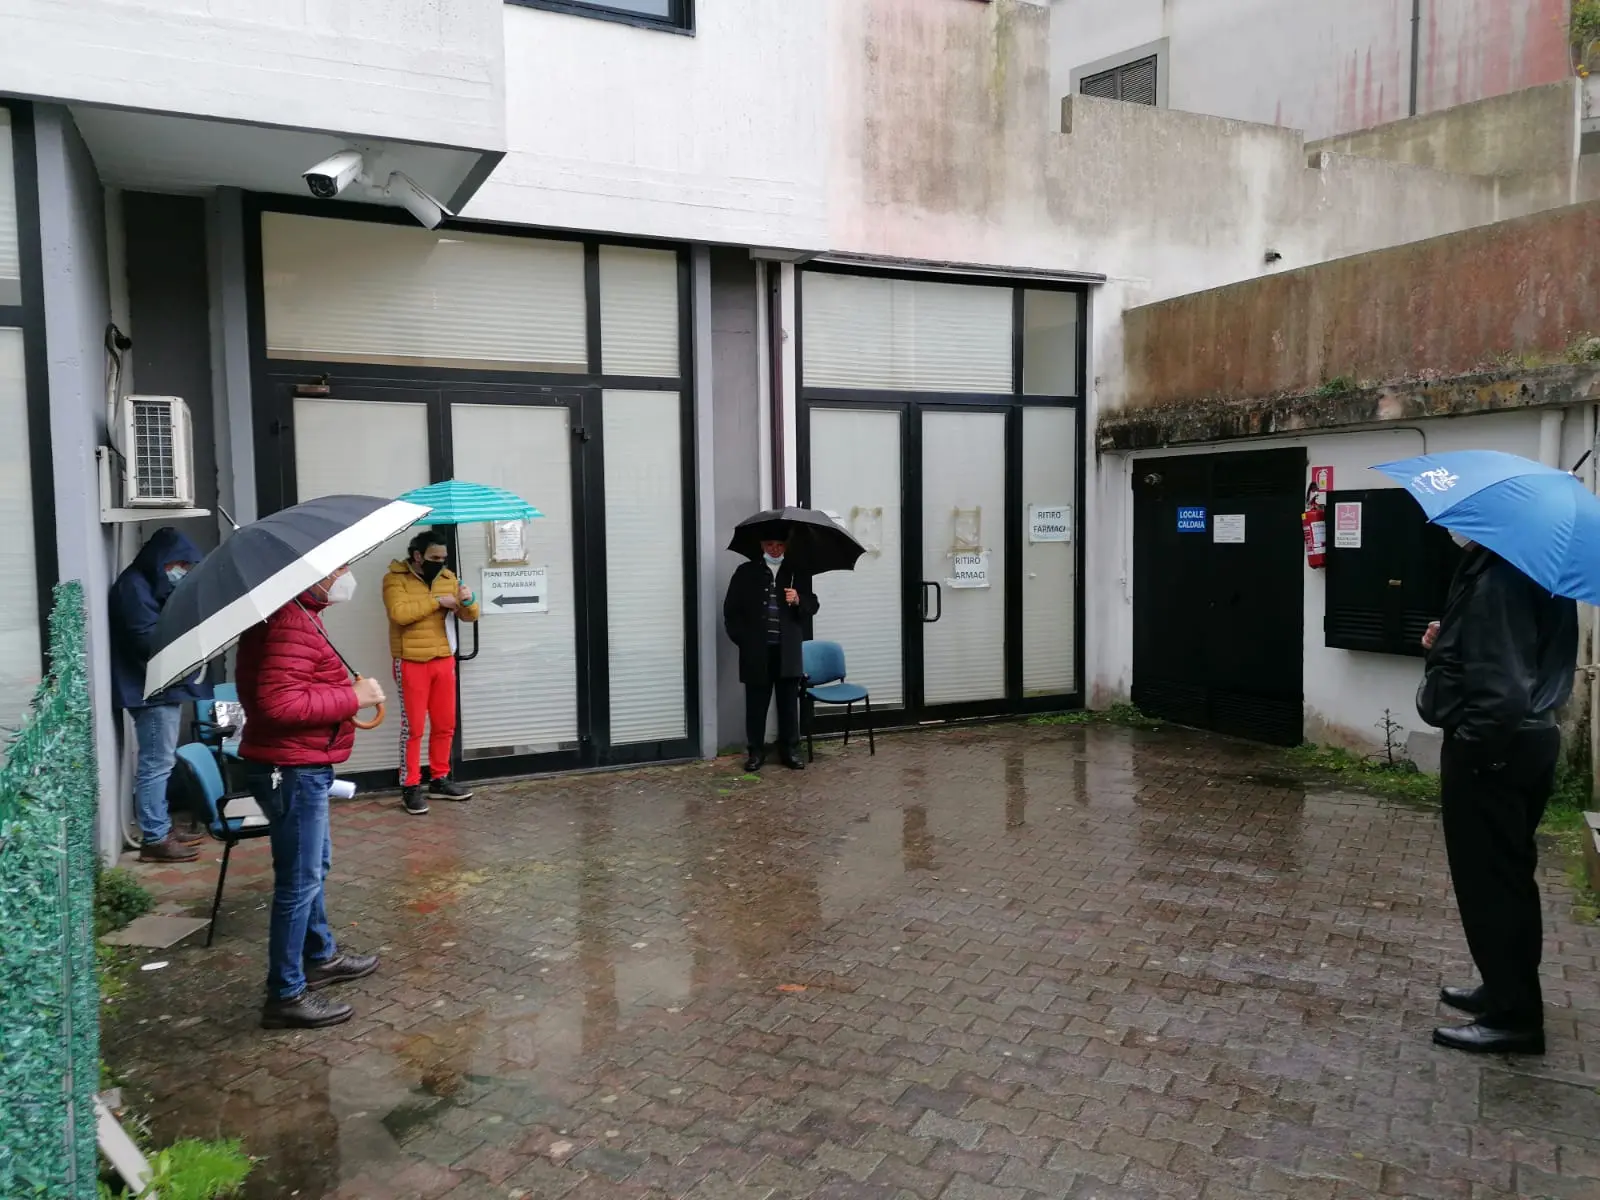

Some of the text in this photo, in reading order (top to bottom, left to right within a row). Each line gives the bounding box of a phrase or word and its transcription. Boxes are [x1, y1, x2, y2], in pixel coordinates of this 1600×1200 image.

[1038, 511, 1061, 519] RITIRO
[1180, 511, 1204, 519] LOCALE
[1178, 520, 1205, 528] CALDAIA
[1034, 525, 1066, 533] FARMACI
